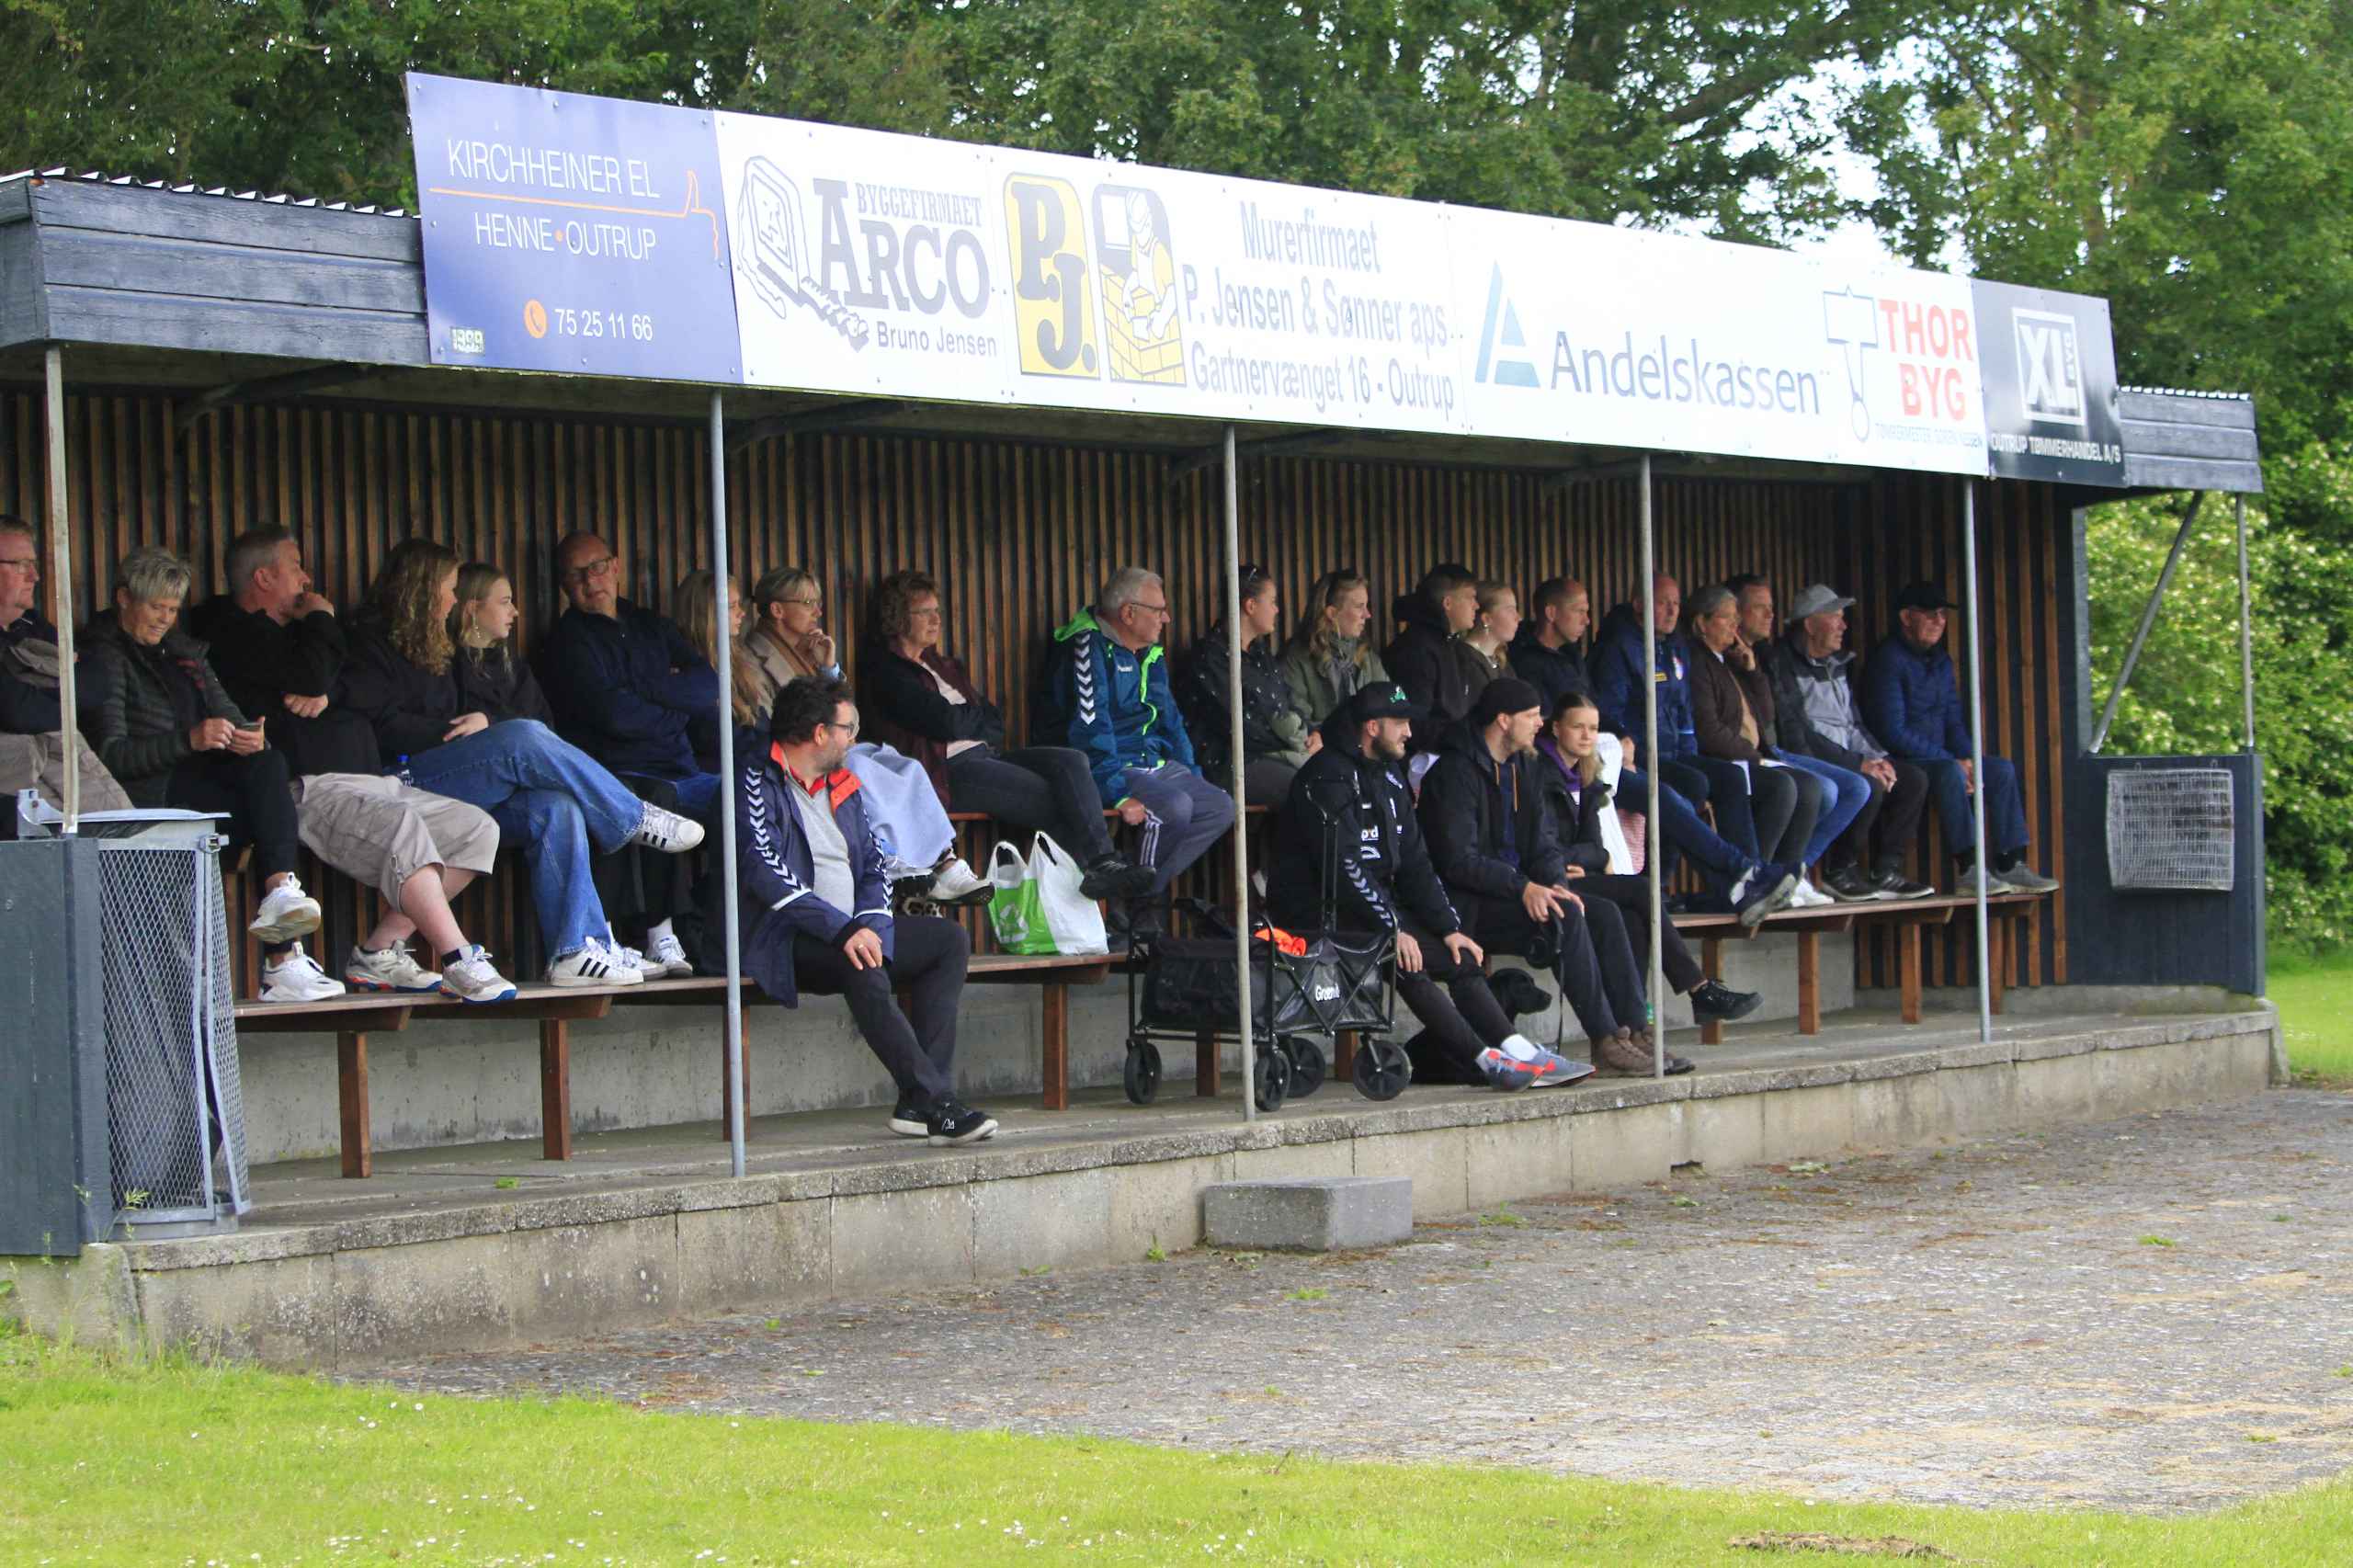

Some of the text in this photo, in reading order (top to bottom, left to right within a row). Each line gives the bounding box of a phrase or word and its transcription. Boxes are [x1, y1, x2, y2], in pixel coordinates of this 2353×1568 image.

[448, 139, 661, 199] KIRCHHEINER EL
[474, 212, 656, 261] HENNE OUTRUP
[813, 177, 991, 319] ARCO
[1240, 200, 1381, 275] Murerfirmaet
[554, 308, 654, 342] 75 25 11 66
[1182, 264, 1206, 324] P.
[1212, 267, 1295, 332] Jensen
[1301, 276, 1318, 335] &
[1323, 278, 1403, 342] Sønner
[1878, 299, 1974, 362] THOR
[876, 321, 997, 357] Bruno Jensen
[2018, 324, 2078, 408] XL
[1191, 341, 1455, 422] Gartnervænget 16 Outrup
[1551, 331, 1820, 415] Andelskassen
[1898, 363, 1967, 421] BYG
[1991, 433, 2028, 453] OUTRUP
